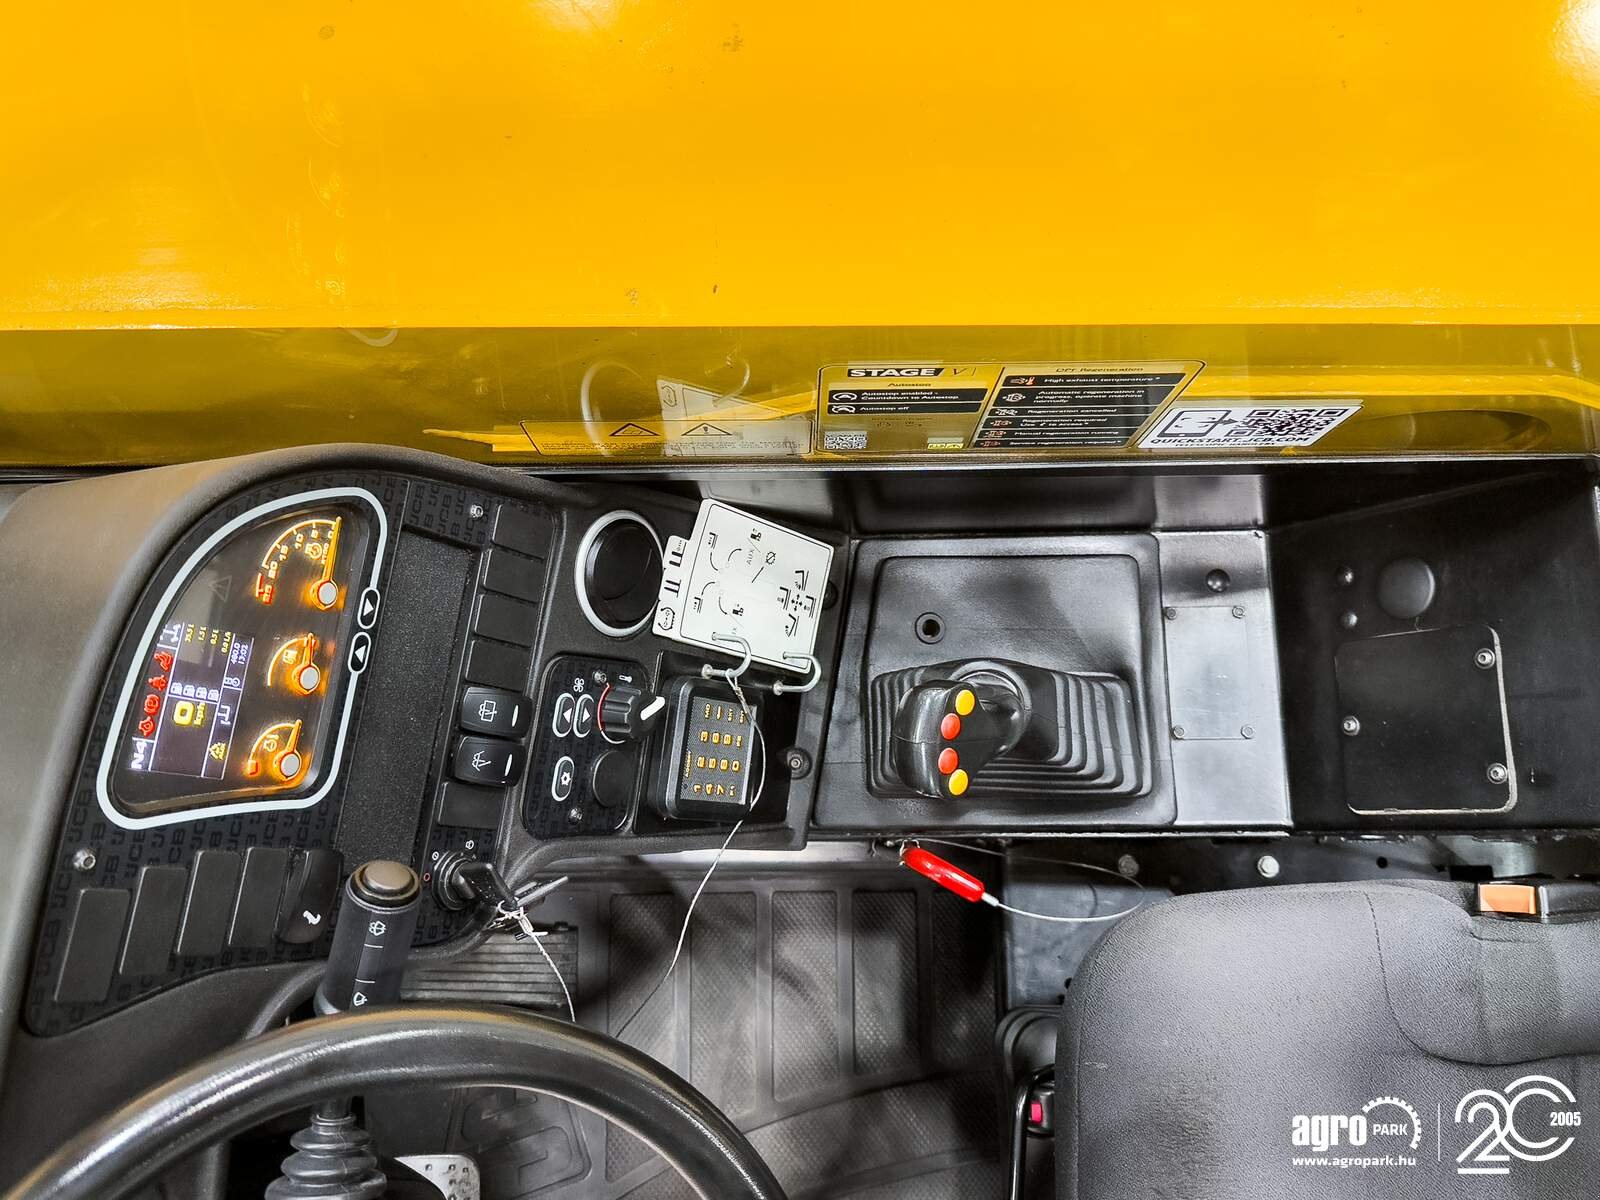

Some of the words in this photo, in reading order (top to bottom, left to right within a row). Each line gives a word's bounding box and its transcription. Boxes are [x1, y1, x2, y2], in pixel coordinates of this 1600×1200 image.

[850, 368, 936, 377] STAGE
[311, 529, 319, 539] 5
[295, 533, 304, 550] 10
[279, 545, 289, 561] 15
[268, 561, 278, 579] 20
[173, 700, 194, 726] 0
[194, 702, 206, 727] kph
[700, 731, 709, 742] 3
[131, 740, 147, 769] N4
[697, 756, 706, 768] 2
[732, 760, 740, 771] 0
[694, 783, 702, 793] 1
[706, 783, 714, 795] 4
[717, 784, 725, 795] 7
